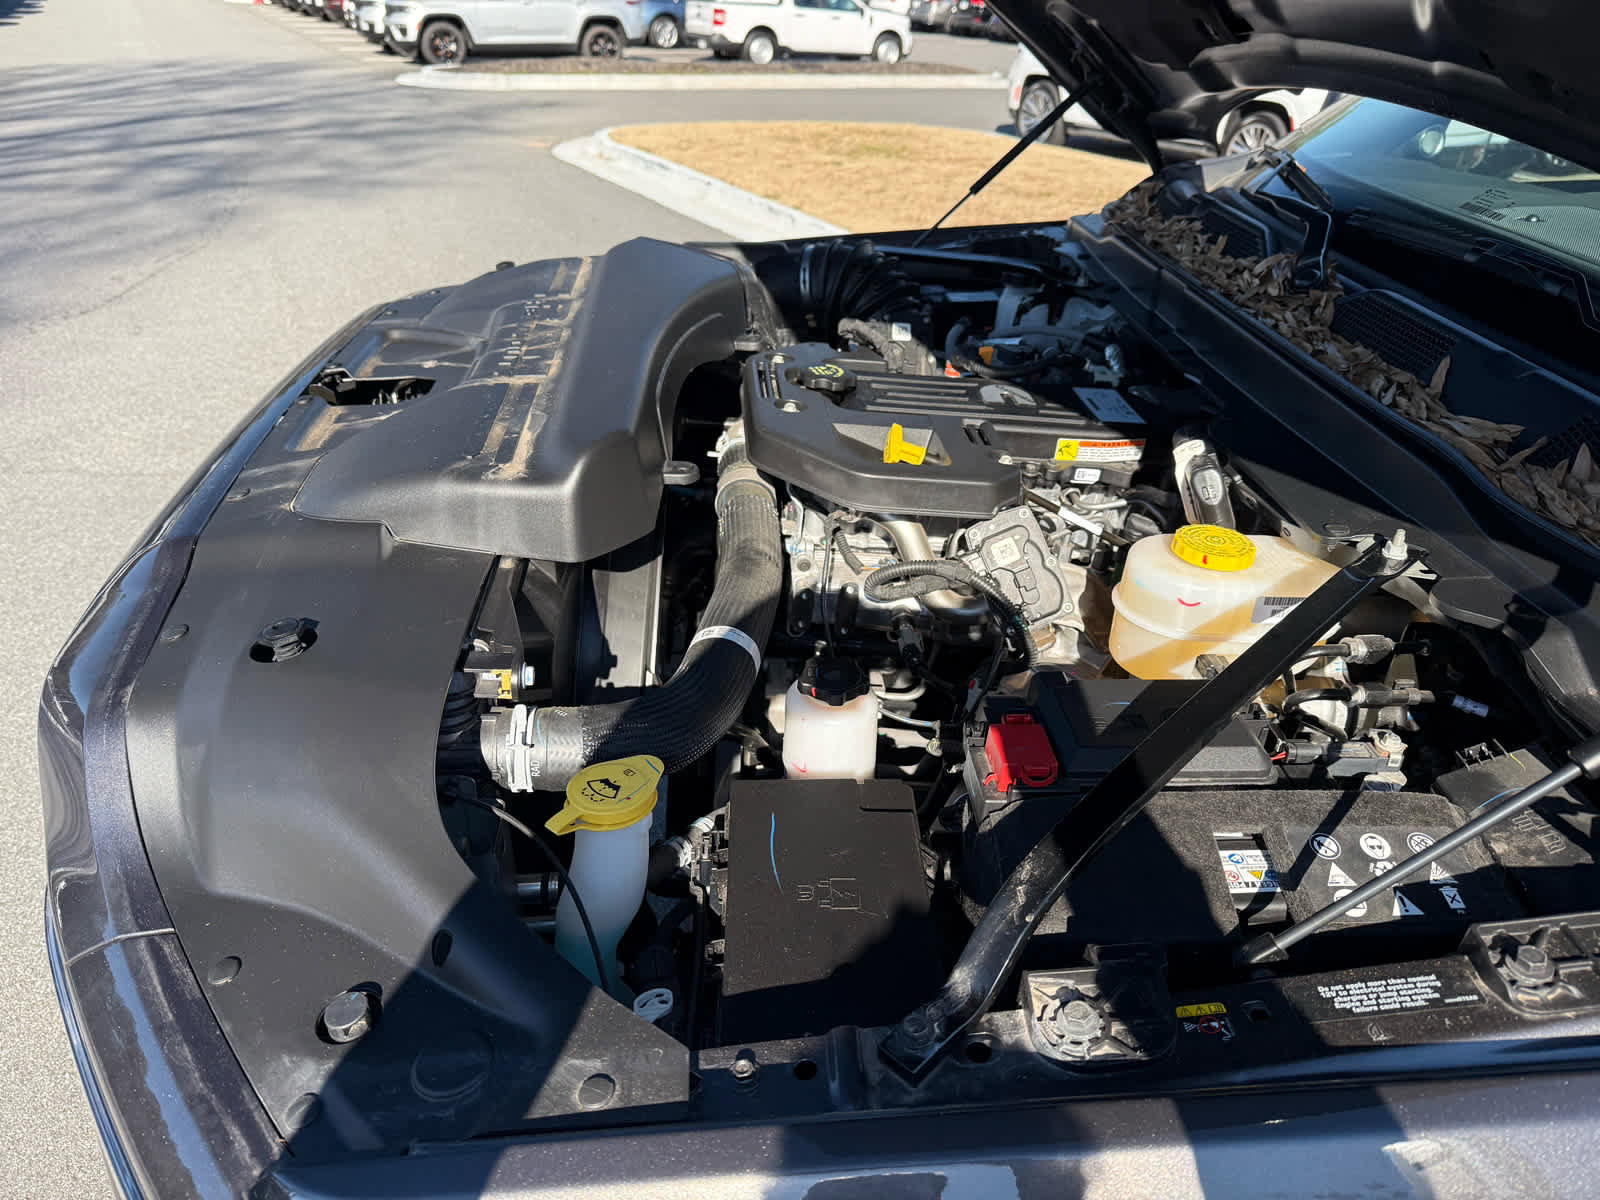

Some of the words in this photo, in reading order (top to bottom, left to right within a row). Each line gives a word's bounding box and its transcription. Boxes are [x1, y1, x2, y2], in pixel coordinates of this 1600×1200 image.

[1320, 990, 1337, 998] 12V
[1349, 985, 1386, 995] electrical
[1386, 983, 1415, 992] system
[1415, 980, 1442, 989] during
[1345, 981, 1366, 990] apply
[1387, 977, 1407, 985] than
[1333, 994, 1368, 1003] charging
[1334, 1000, 1361, 1009] Engine
[1361, 998, 1377, 1006] and
[1377, 995, 1411, 1004] starting
[1411, 992, 1441, 1002] system
[1379, 1001, 1401, 1010] could
